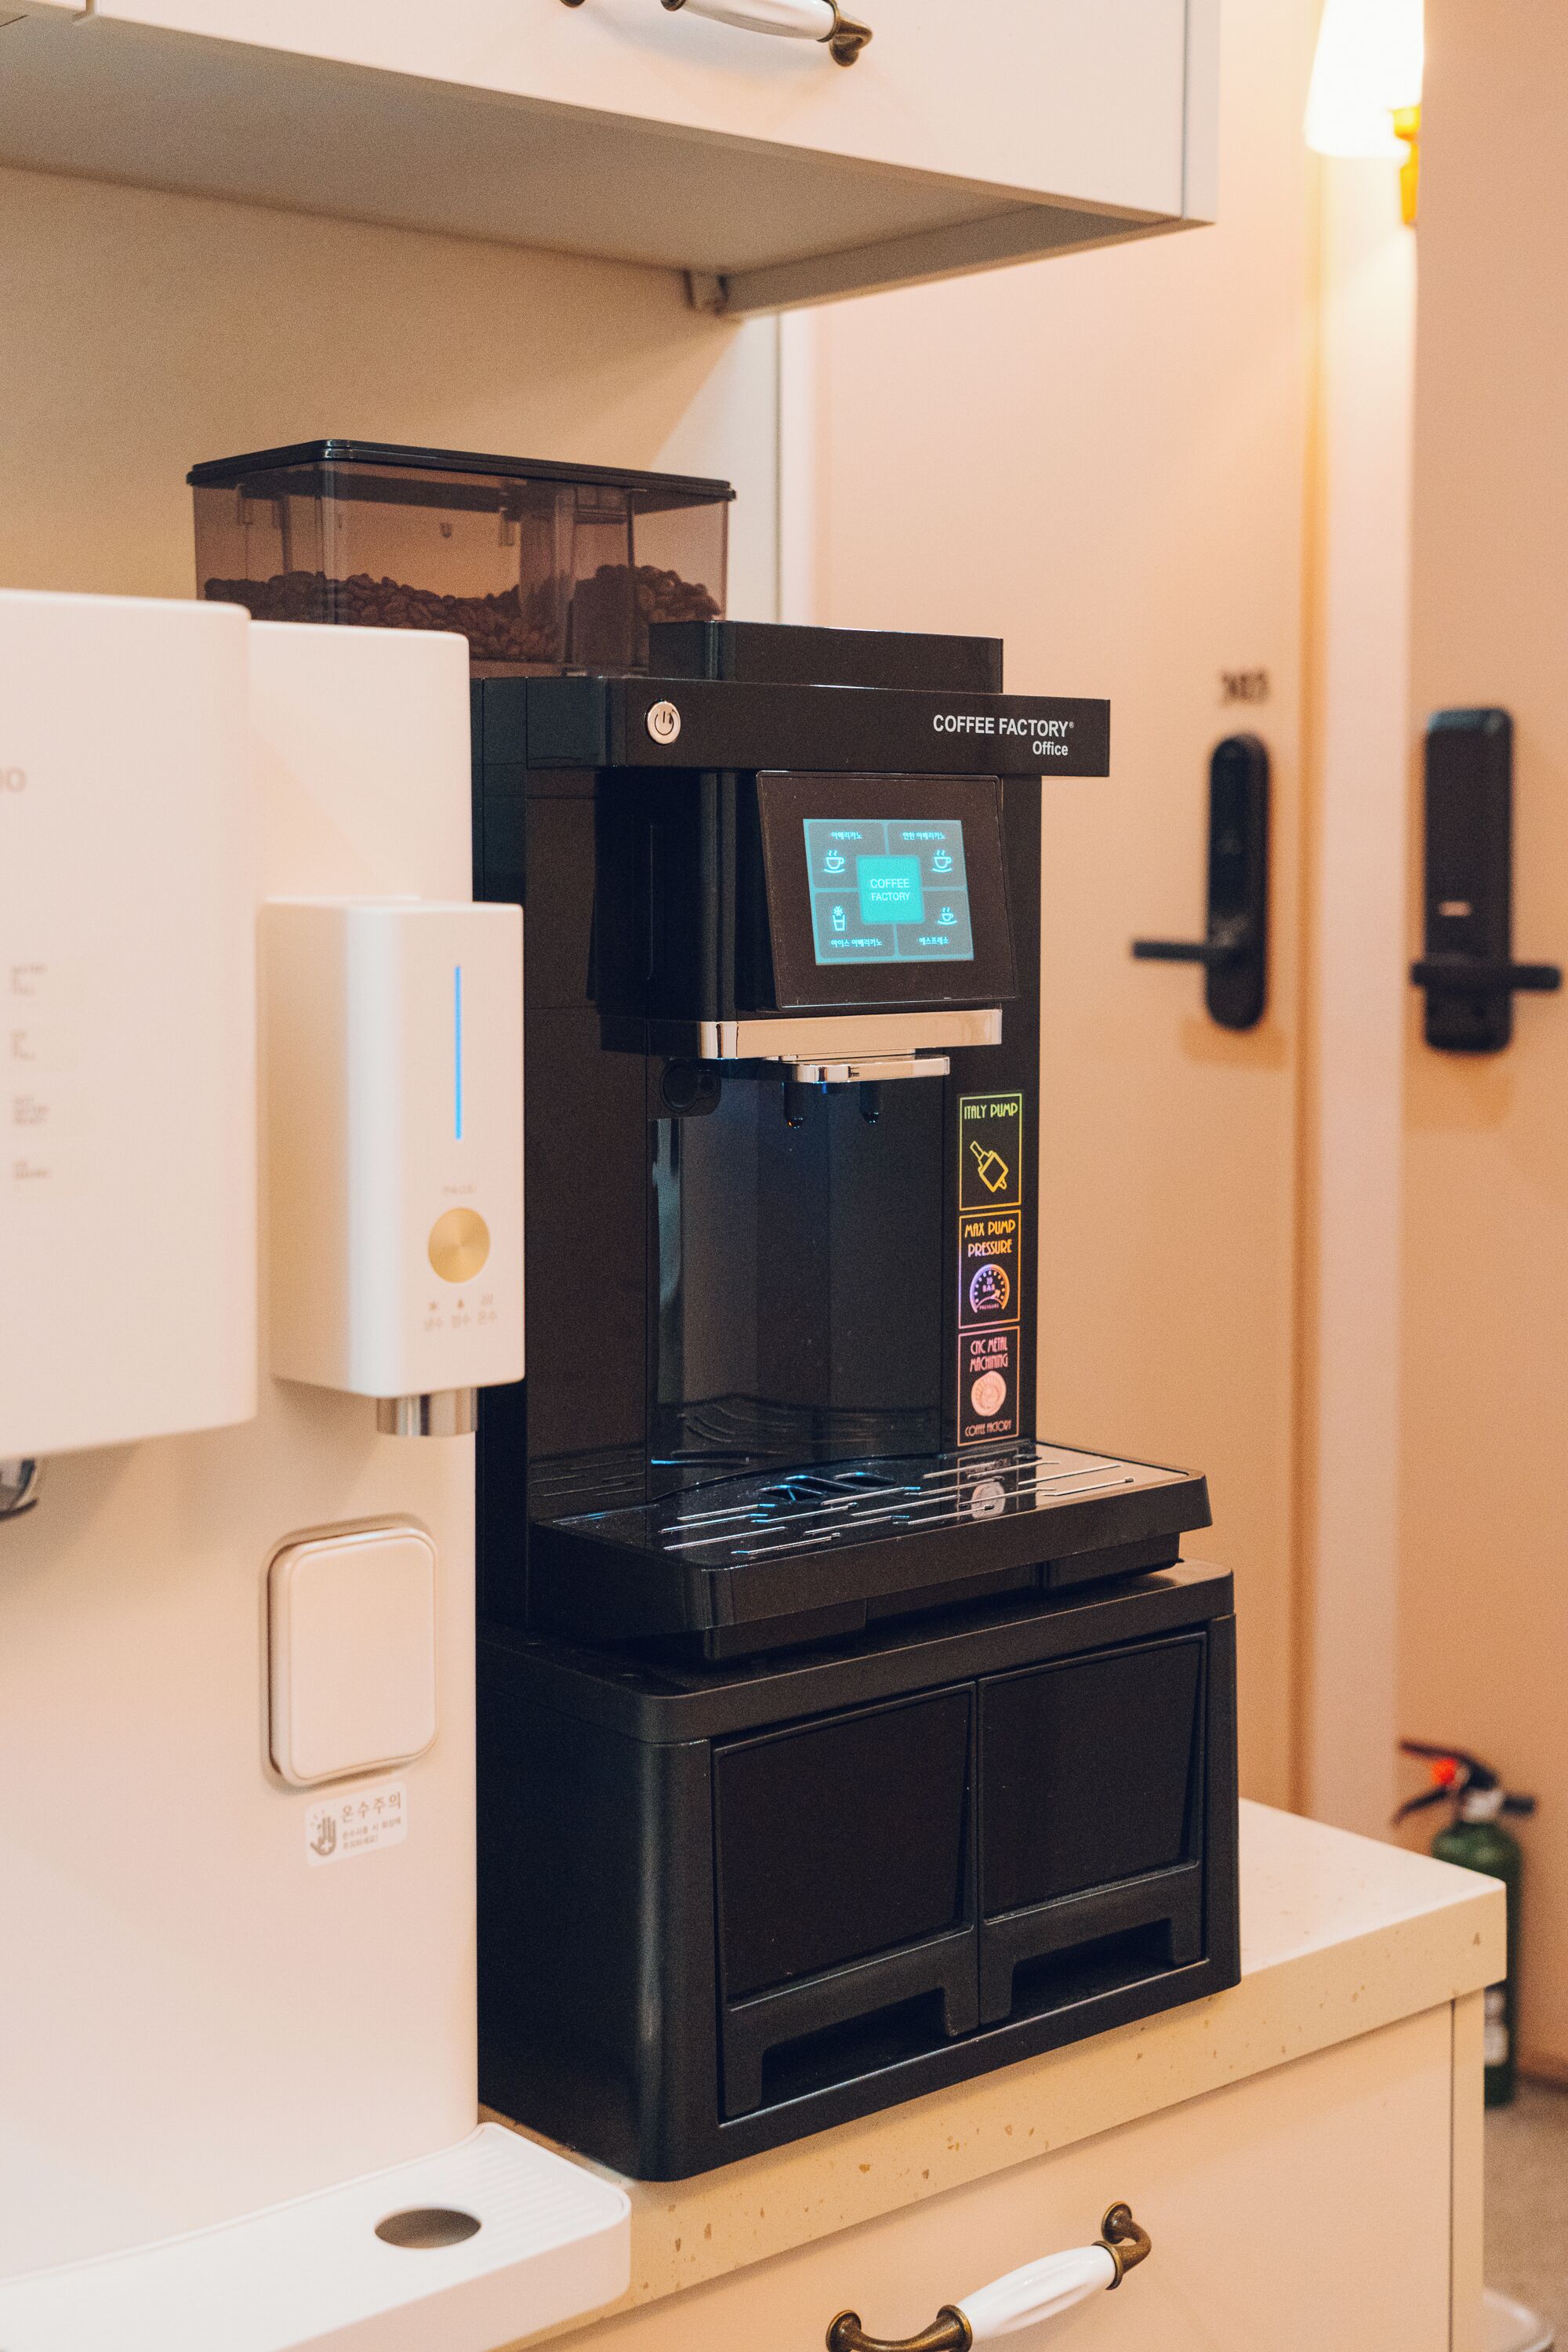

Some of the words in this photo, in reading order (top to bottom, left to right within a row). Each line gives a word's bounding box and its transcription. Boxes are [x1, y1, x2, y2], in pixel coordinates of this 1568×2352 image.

[933, 714, 995, 735] COFFEE
[1033, 741, 1069, 756] Office
[831, 831, 862, 840] 아메리카노
[902, 832, 915, 840] 연한
[916, 831, 946, 840] 아메리카노
[869, 878, 910, 889] COFFEE
[871, 892, 910, 902] FACTORY
[831, 938, 850, 947] 아이스
[851, 938, 883, 947] 아메리카노
[919, 936, 949, 946] 에스프레소
[964, 1105, 986, 1120] ITALY
[990, 1102, 1018, 1118] PUMP
[964, 1221, 985, 1239] MAX
[988, 1219, 1016, 1236] PUMP
[967, 1239, 1012, 1258] PRESSURE
[970, 1338, 986, 1356] CNC
[987, 1336, 1008, 1353] METAL
[970, 1352, 1008, 1373] MACHINING
[964, 1423, 985, 1437] COFFEE
[986, 1419, 1012, 1434] FACTORY
